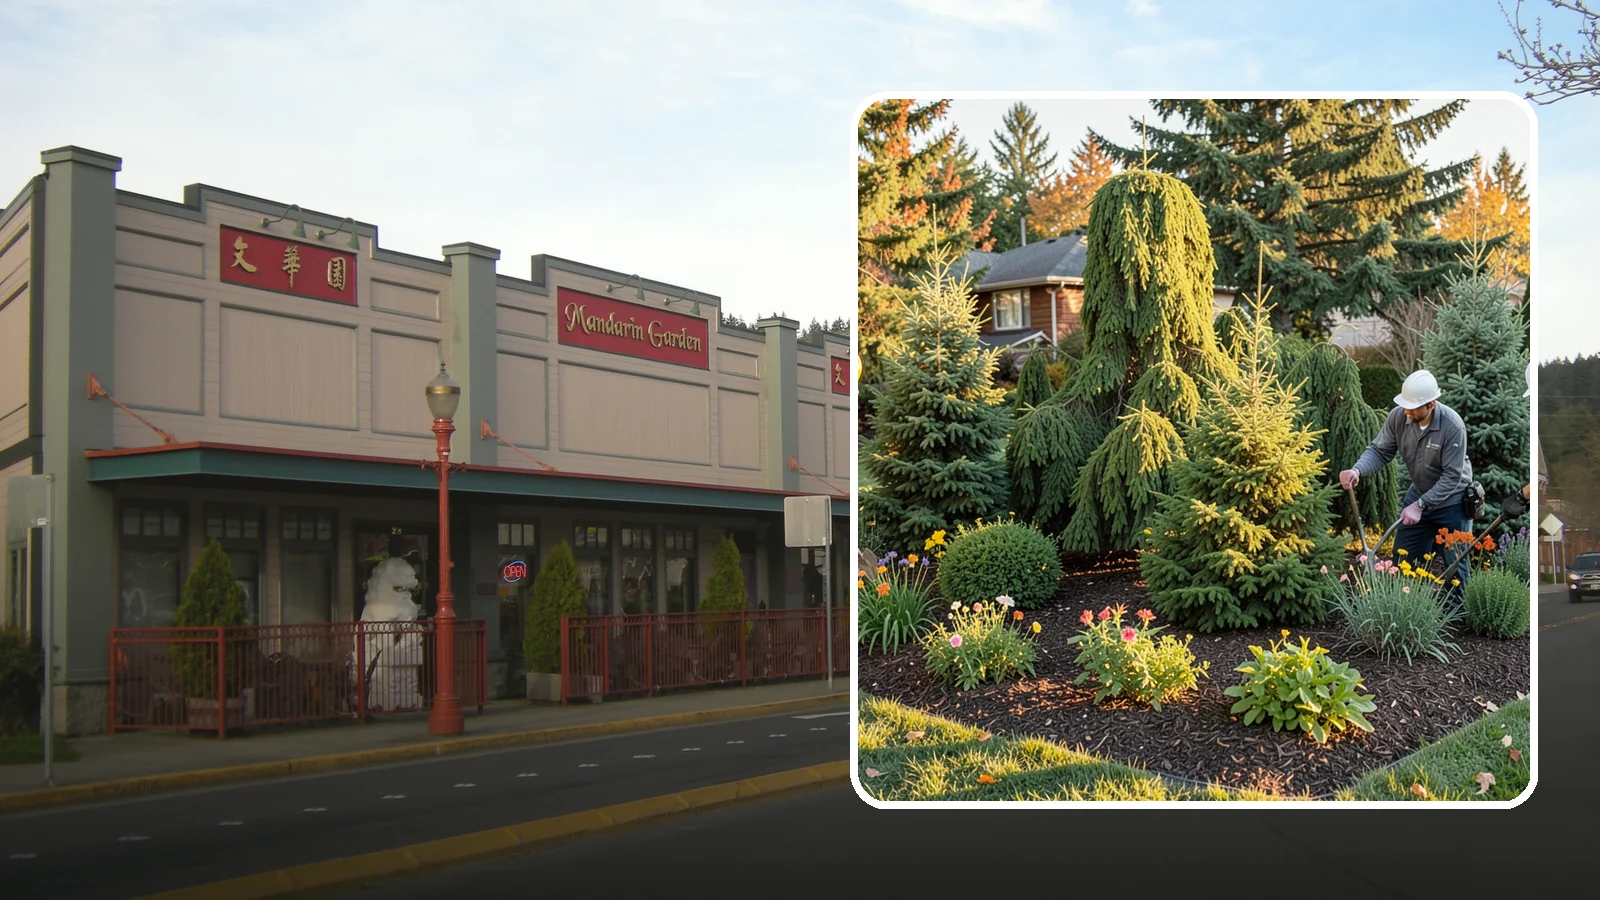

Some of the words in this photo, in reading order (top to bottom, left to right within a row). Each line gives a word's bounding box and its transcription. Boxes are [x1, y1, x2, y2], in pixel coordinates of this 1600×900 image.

[231, 236, 347, 291] 文華園
[564, 302, 644, 341] Mandarin
[648, 320, 702, 352] Garden
[503, 565, 527, 578] OPEN
